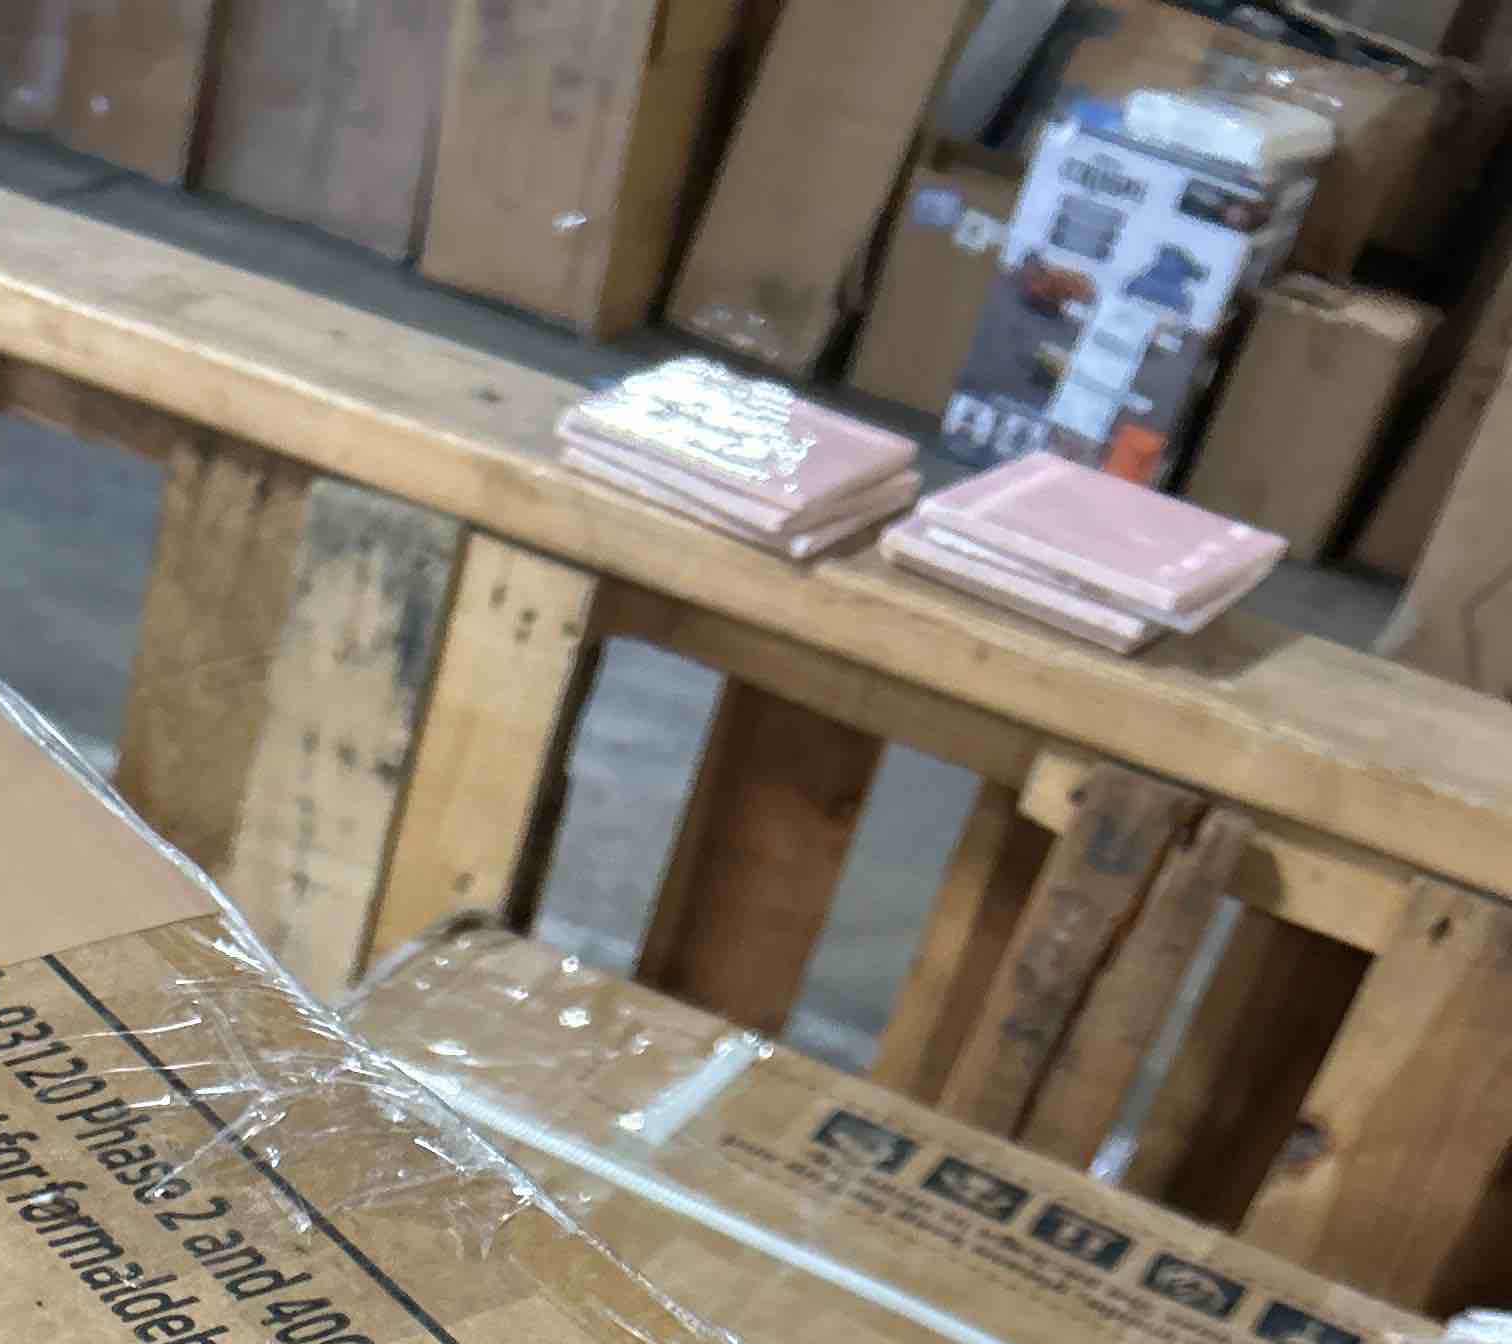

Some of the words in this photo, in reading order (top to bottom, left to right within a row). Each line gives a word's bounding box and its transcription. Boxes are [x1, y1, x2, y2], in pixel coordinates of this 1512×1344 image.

[56, 1098, 193, 1206] Phase
[154, 1196, 226, 1233] 2
[182, 1217, 311, 1326] and
